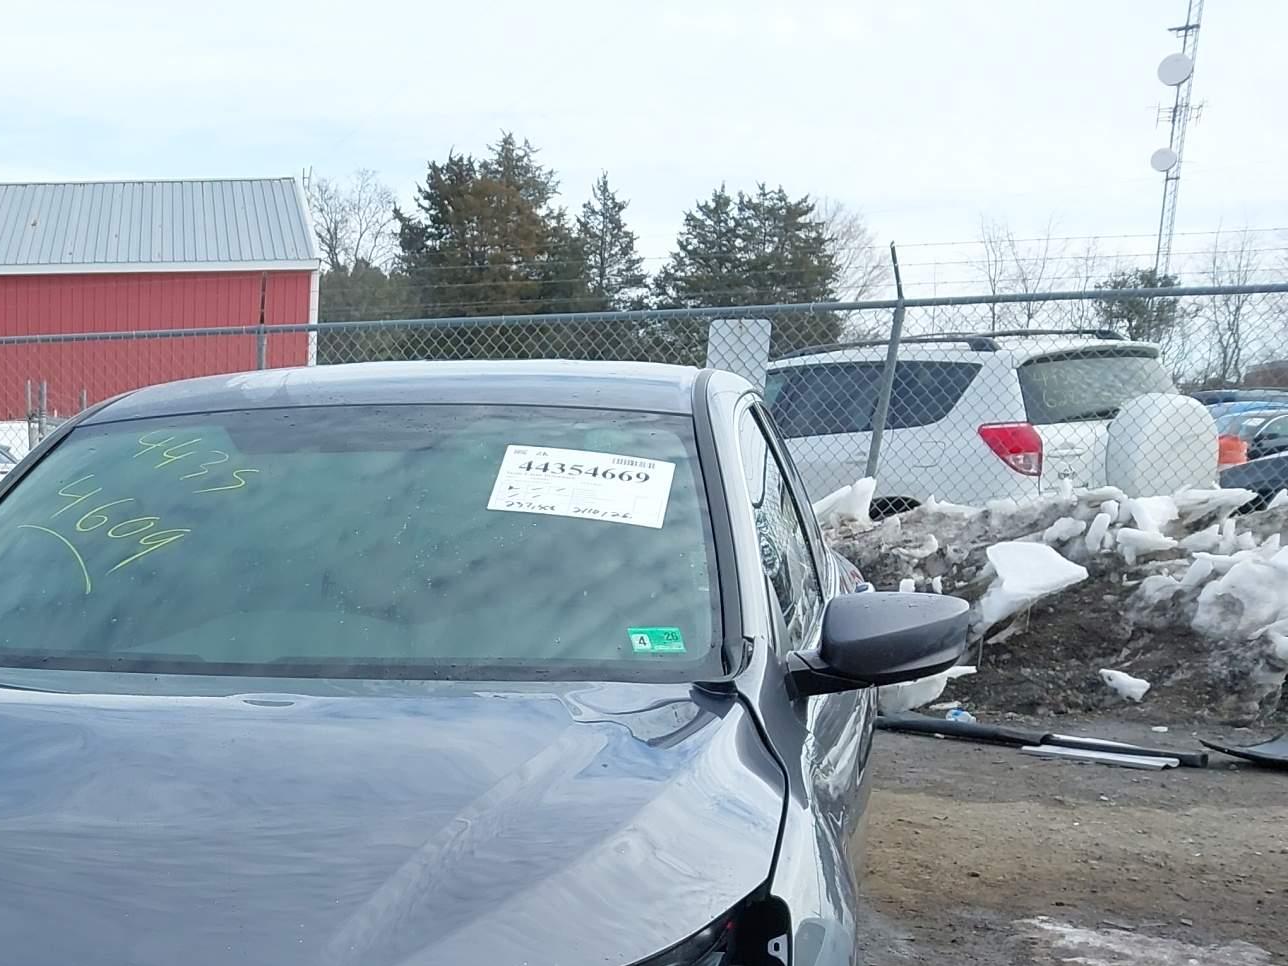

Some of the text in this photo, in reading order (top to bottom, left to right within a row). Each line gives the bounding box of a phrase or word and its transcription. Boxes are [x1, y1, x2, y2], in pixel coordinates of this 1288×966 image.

[132, 430, 260, 494] 4435
[517, 459, 651, 484] 44354669
[49, 474, 192, 576] 4609
[638, 635, 647, 646] 4
